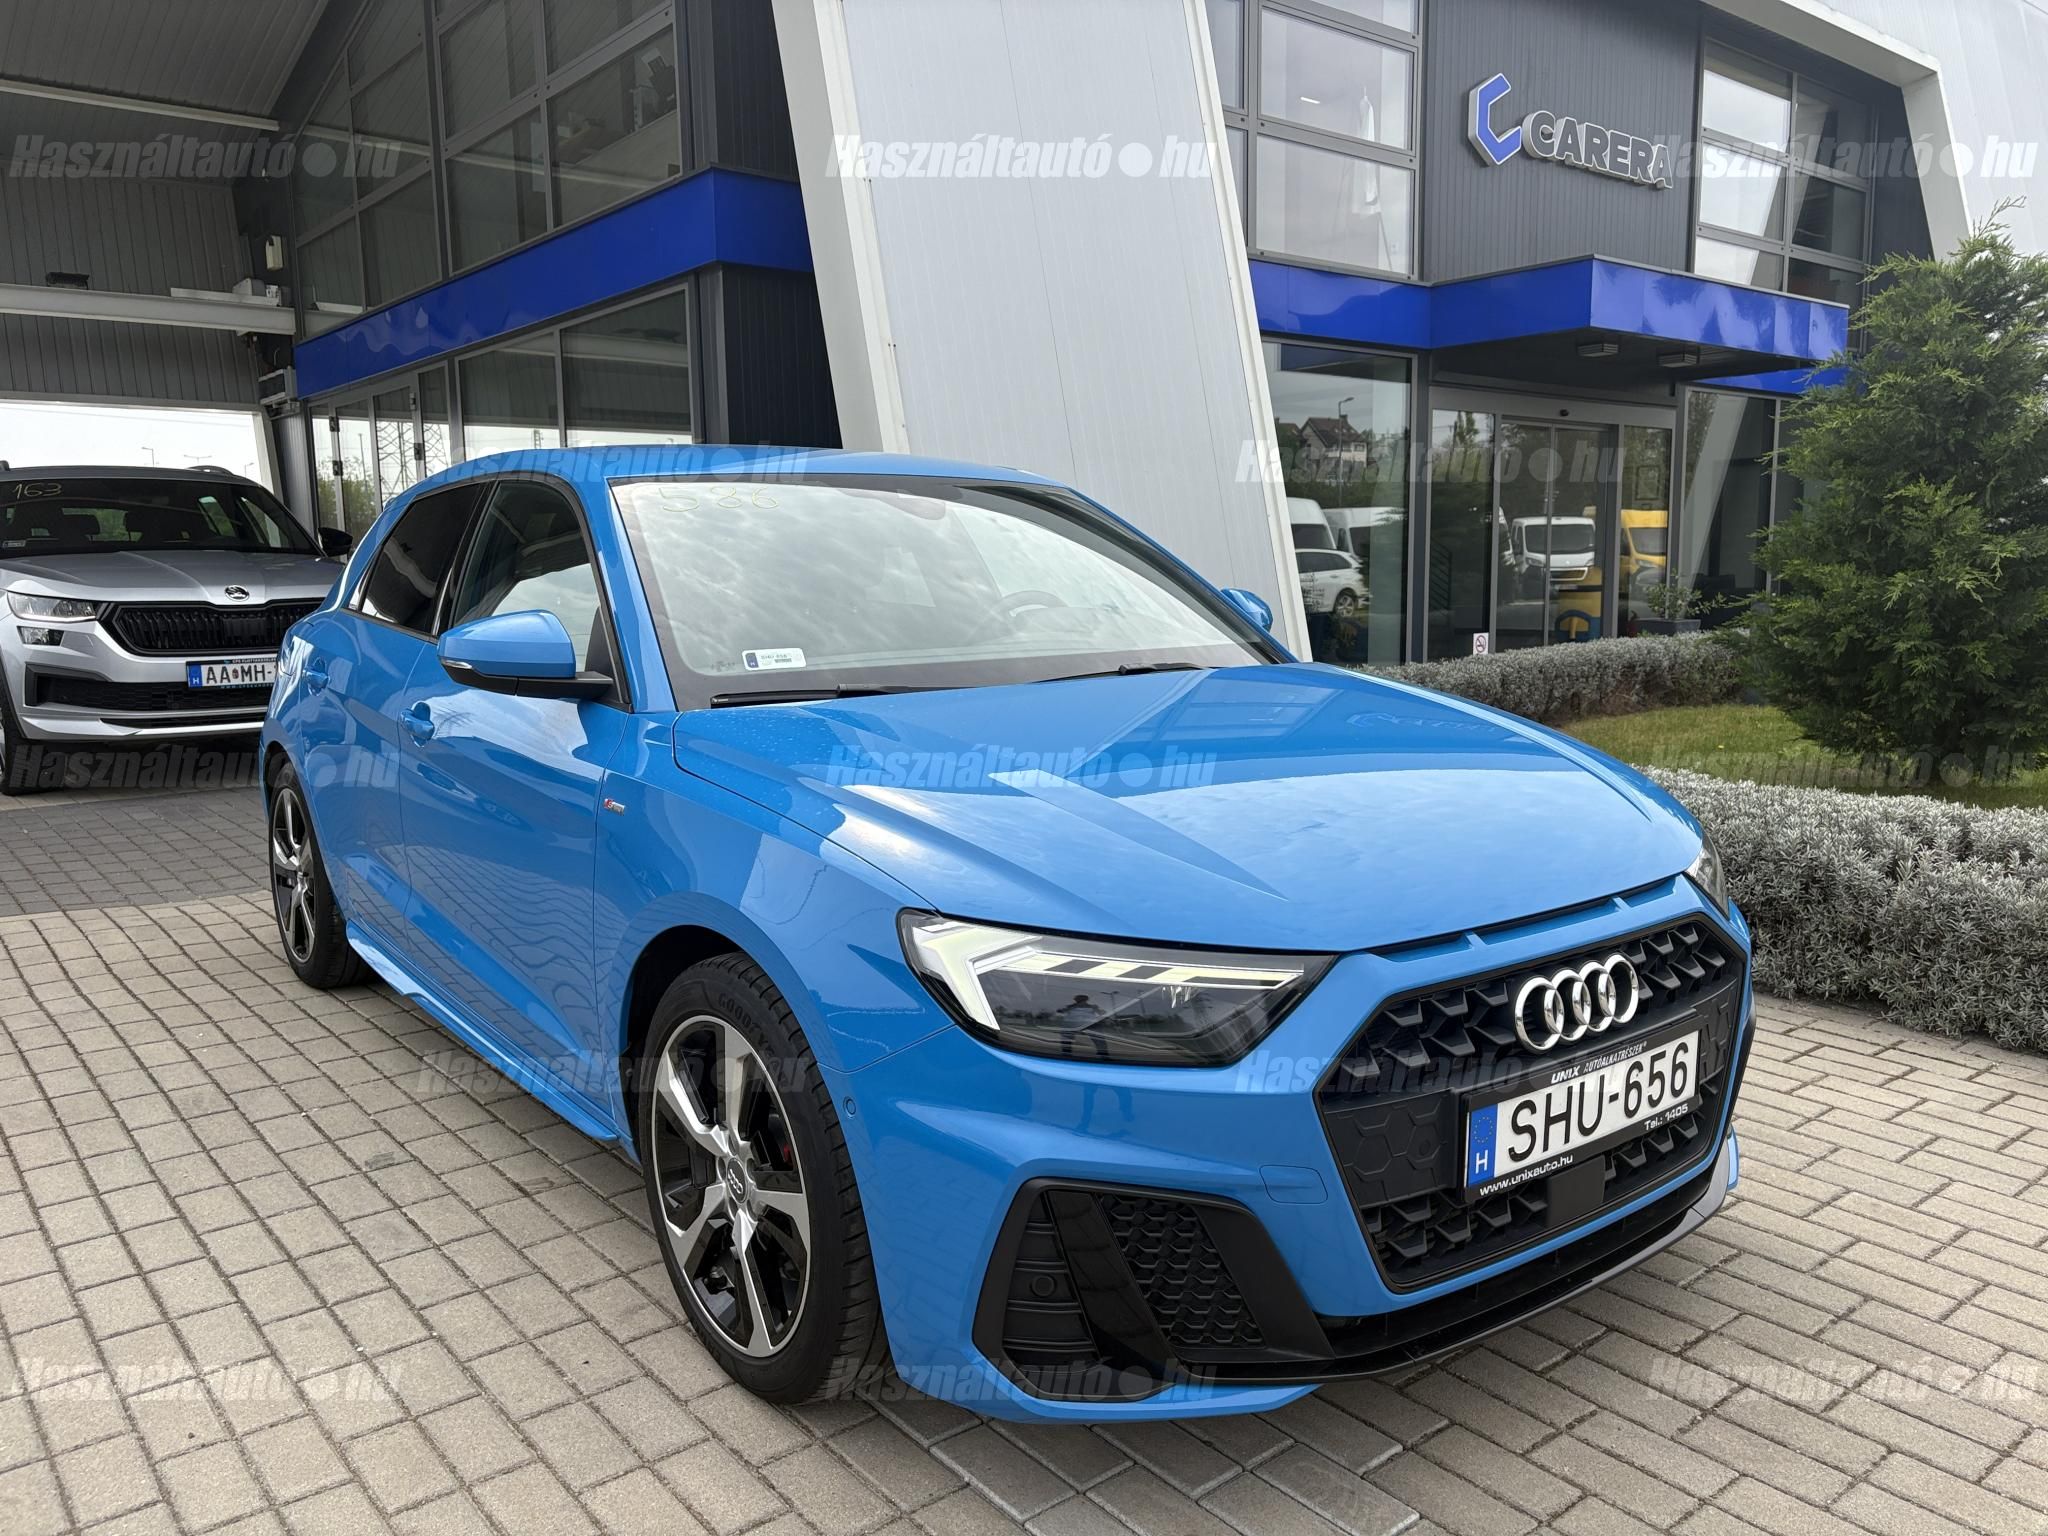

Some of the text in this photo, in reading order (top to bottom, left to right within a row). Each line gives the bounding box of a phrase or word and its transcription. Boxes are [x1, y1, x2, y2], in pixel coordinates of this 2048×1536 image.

[1523, 110, 1673, 189] CARERA
[12, 482, 62, 499] 163
[658, 486, 779, 512] 586
[193, 677, 200, 685] H
[206, 664, 277, 684] AA MH-
[1550, 1065, 1580, 1084] UNIX
[1507, 1041, 1690, 1163] SHU-656
[1644, 1103, 1689, 1131] Tel.: 1405
[1475, 1150, 1488, 1174] H
[1479, 1154, 1574, 1197] www.unixauto.hu
